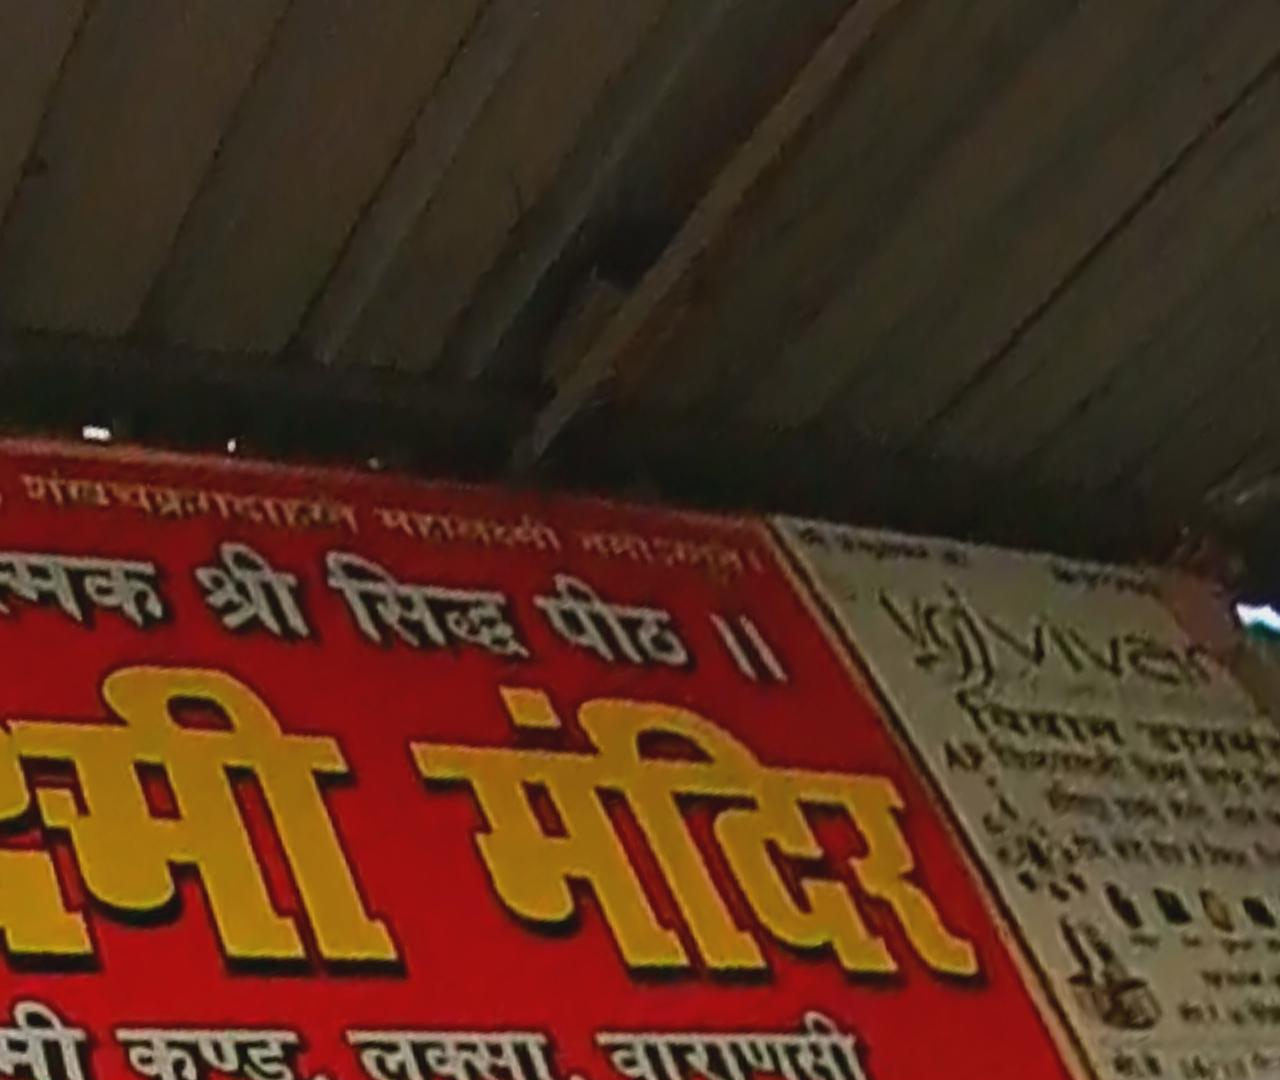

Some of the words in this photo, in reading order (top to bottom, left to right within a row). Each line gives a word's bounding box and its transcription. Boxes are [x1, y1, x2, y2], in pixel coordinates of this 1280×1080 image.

[195, 540, 313, 640] श्री
[326, 550, 531, 661] सिद्ध
[535, 570, 690, 669] पीठ
[408, 686, 980, 979] मंदिर
